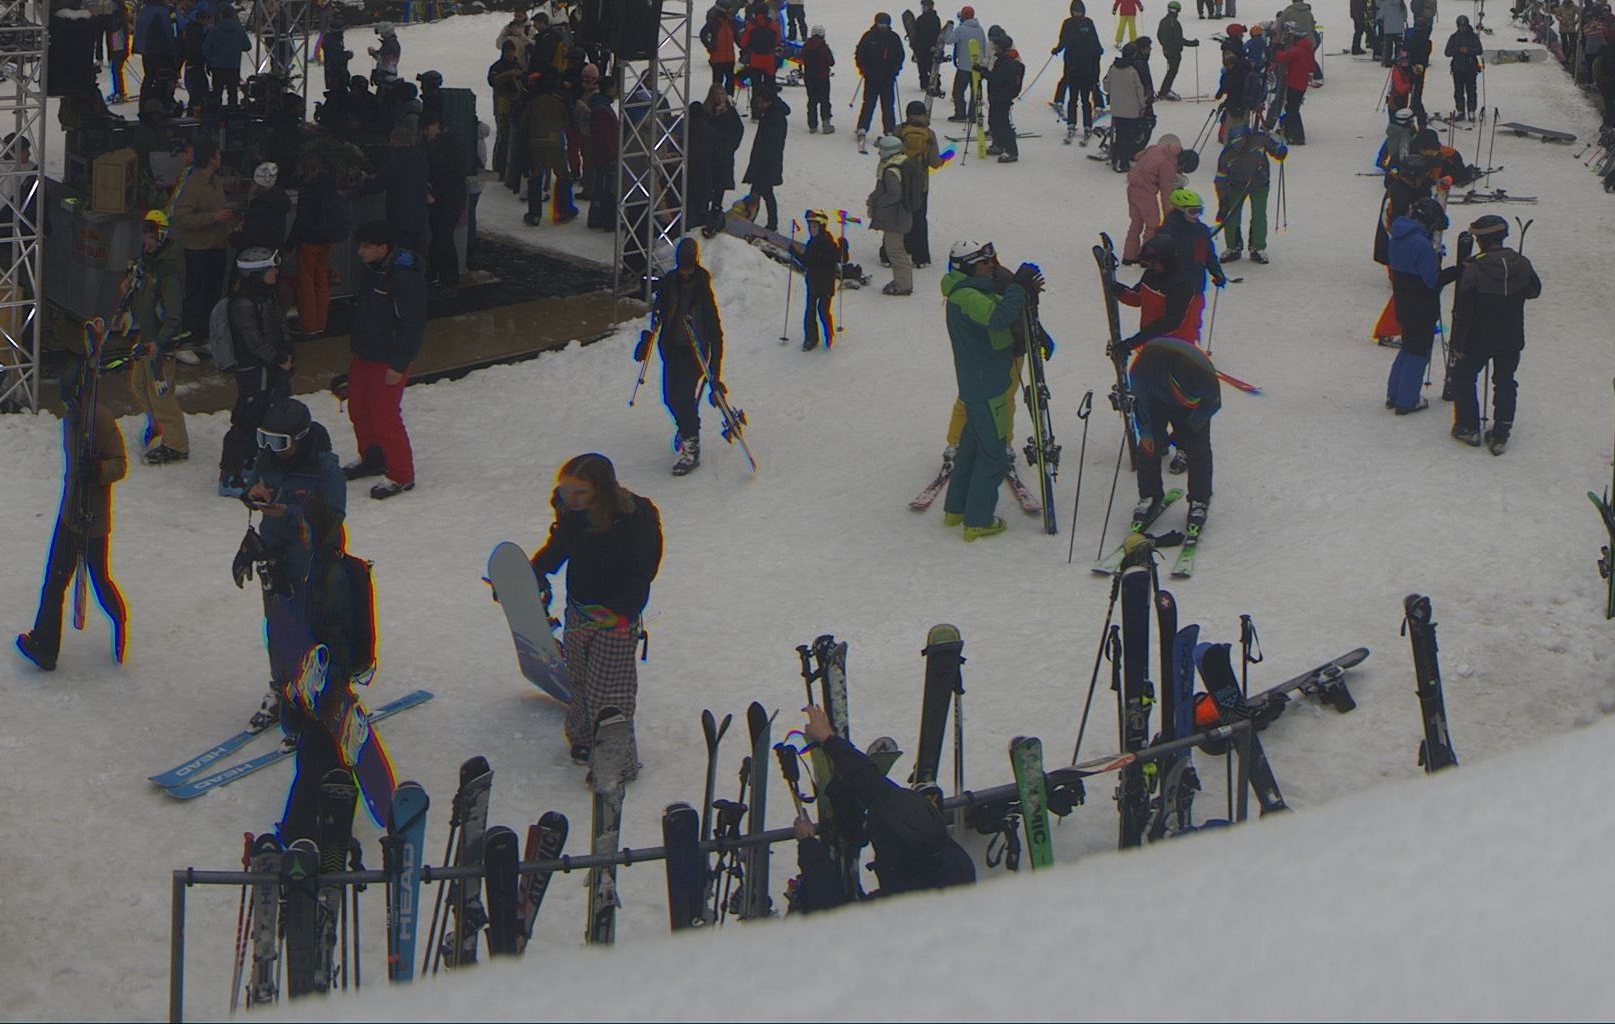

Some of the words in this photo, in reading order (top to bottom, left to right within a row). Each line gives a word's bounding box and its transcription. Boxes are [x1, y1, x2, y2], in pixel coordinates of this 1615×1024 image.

[176, 747, 227, 777] HEAD
[193, 763, 253, 790] HEAD
[400, 843, 414, 941] HEAD
